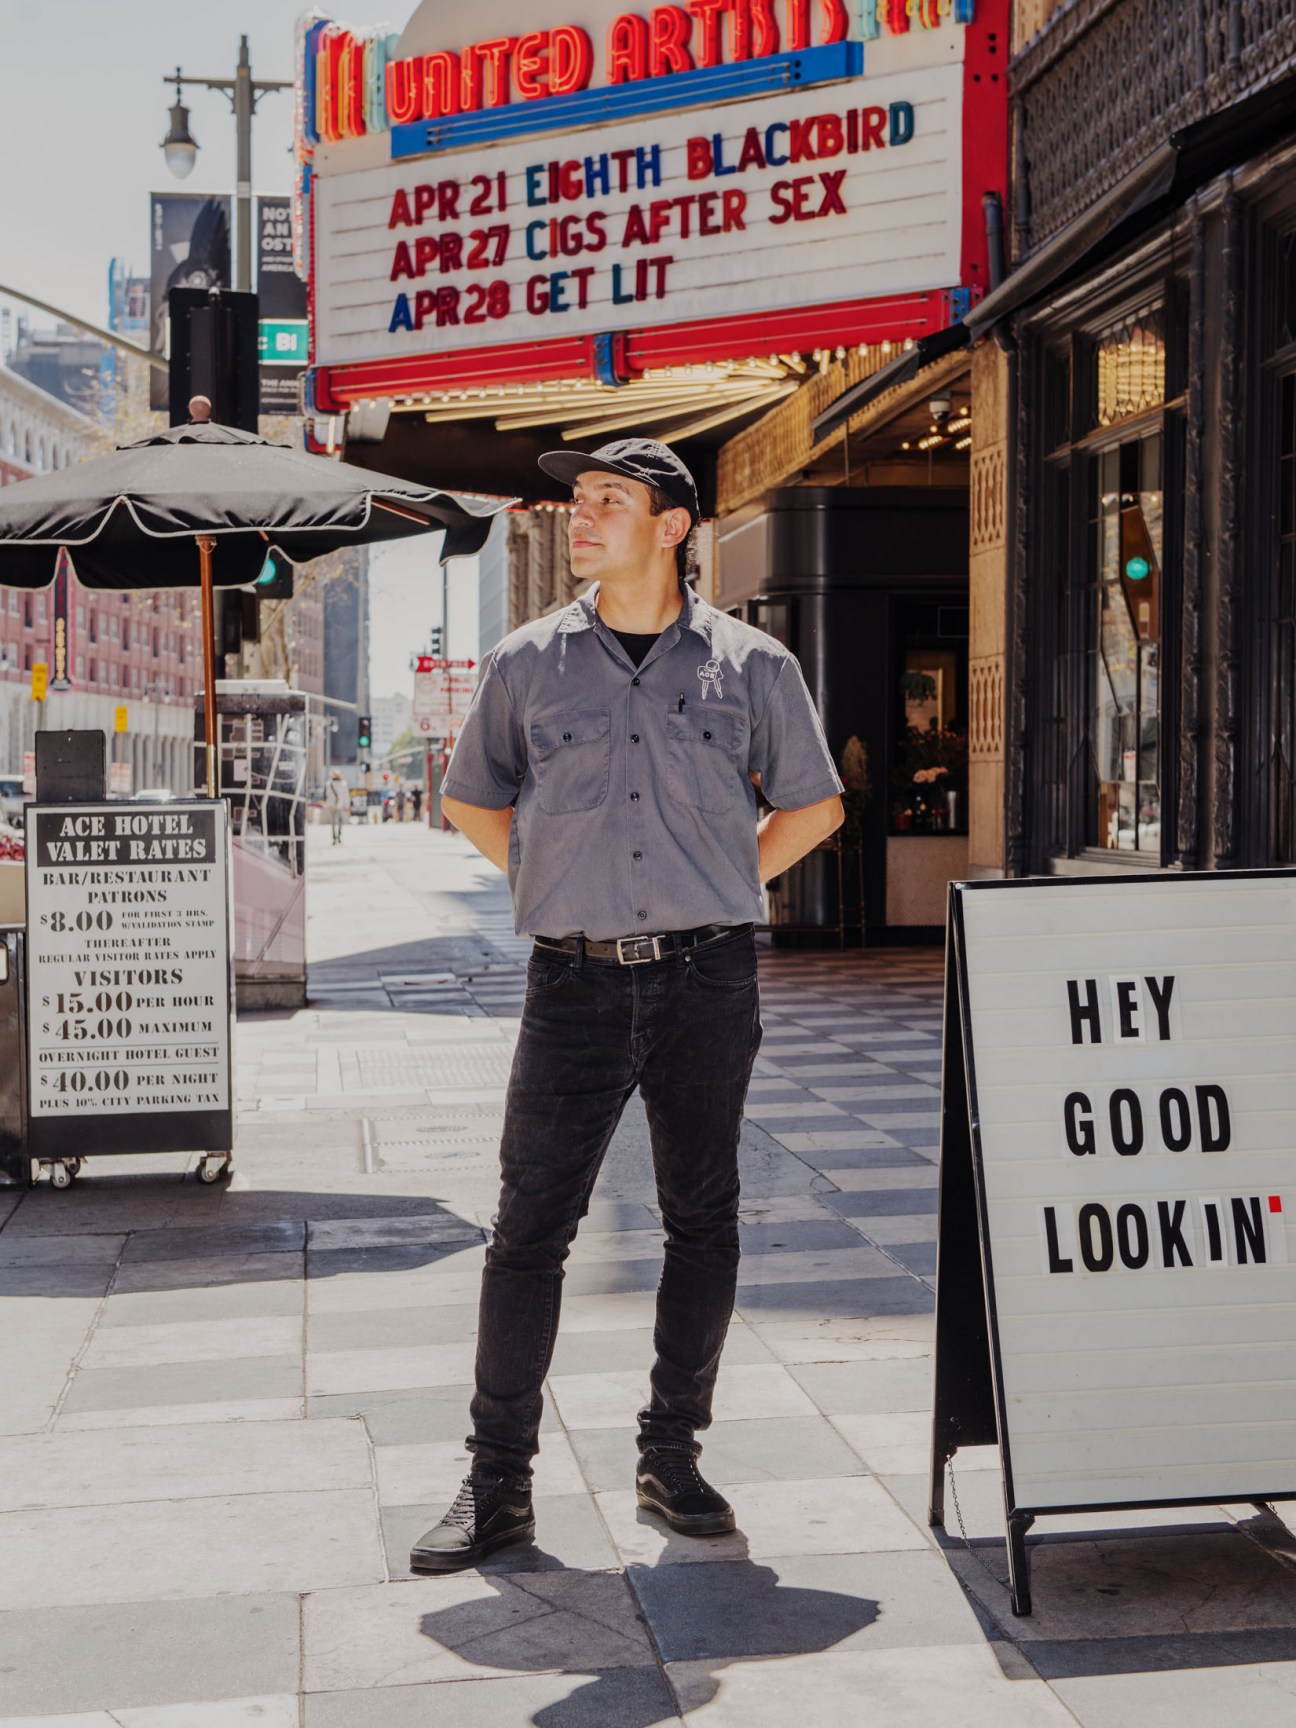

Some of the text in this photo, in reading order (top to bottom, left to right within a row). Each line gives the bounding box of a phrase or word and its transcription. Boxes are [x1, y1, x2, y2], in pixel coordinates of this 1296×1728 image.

[385, 25, 594, 124] UNITED
[388, 101, 915, 229] APR 21 EIGHTH BLACKBIRD
[263, 222, 289, 236] AN
[389, 169, 847, 281] APR 27 CIGS AFTER SEX
[388, 255, 674, 333] APR 28 GET LIT
[60, 814, 193, 837] ACE HOTEL
[46, 838, 207, 862] VALET RATES
[43, 869, 211, 886] BAR/RESTAURANT
[88, 890, 167, 904] PATRONS
[144, 910, 172, 918] FIRST
[121, 920, 214, 929] W/VALIDATION STAMP
[85, 938, 170, 948] THEREAFTER
[39, 950, 216, 963] REGULAR VISITOR RATES APPLY
[74, 968, 183, 987] VISITORS
[136, 997, 165, 1008] PER
[172, 995, 215, 1007] HOUR
[1066, 976, 1175, 1045] HEY
[139, 1021, 213, 1034] MAXIMUM
[39, 1047, 220, 1063] OVERNIGHT HOTEL GUEST
[136, 1074, 165, 1086] PER
[172, 1072, 219, 1085] NIGHT
[39, 1093, 220, 1108] PLUS 10% CITY PARKING TAX
[1063, 1084, 1232, 1156] GOOD
[1043, 1195, 1282, 1274] LOOKIN'
